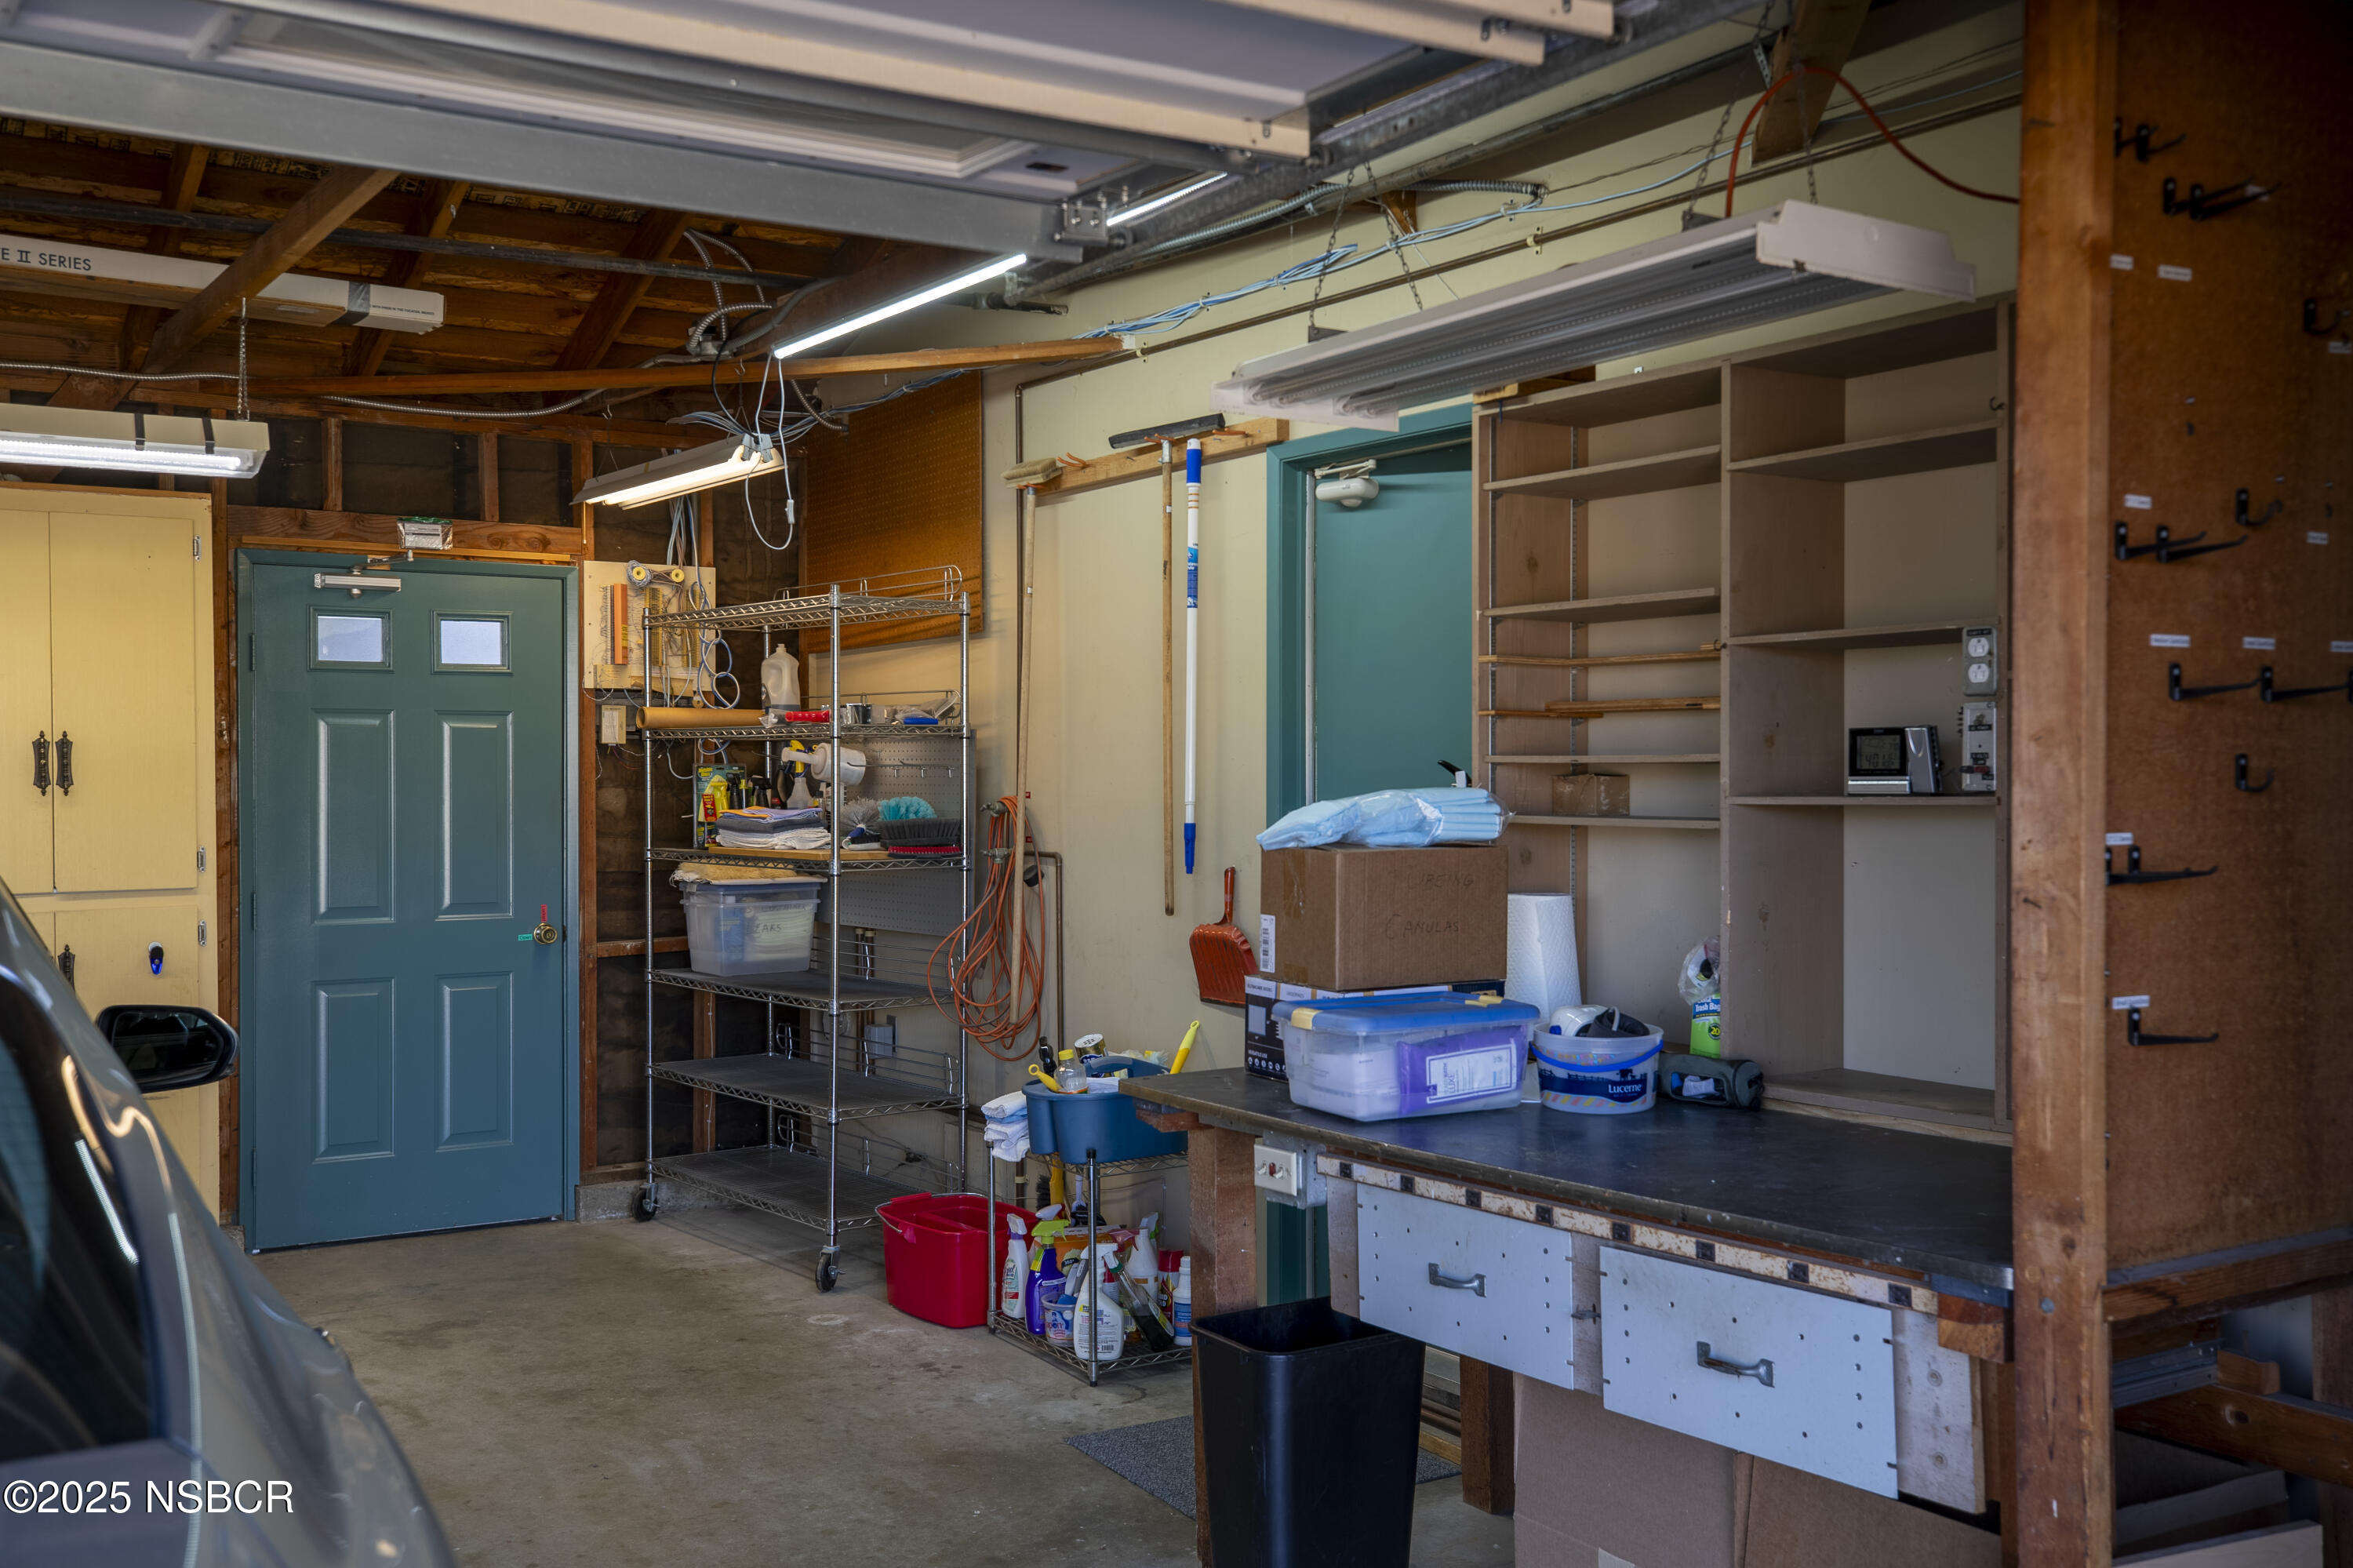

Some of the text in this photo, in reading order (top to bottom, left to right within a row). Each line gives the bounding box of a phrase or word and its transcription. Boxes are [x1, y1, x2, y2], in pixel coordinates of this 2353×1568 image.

[0, 247, 92, 271] E II SERIES
[1695, 1002, 1708, 1013] Trash
[1711, 1026, 1720, 1035] 20
[1608, 1083, 1642, 1093] Lucerne
